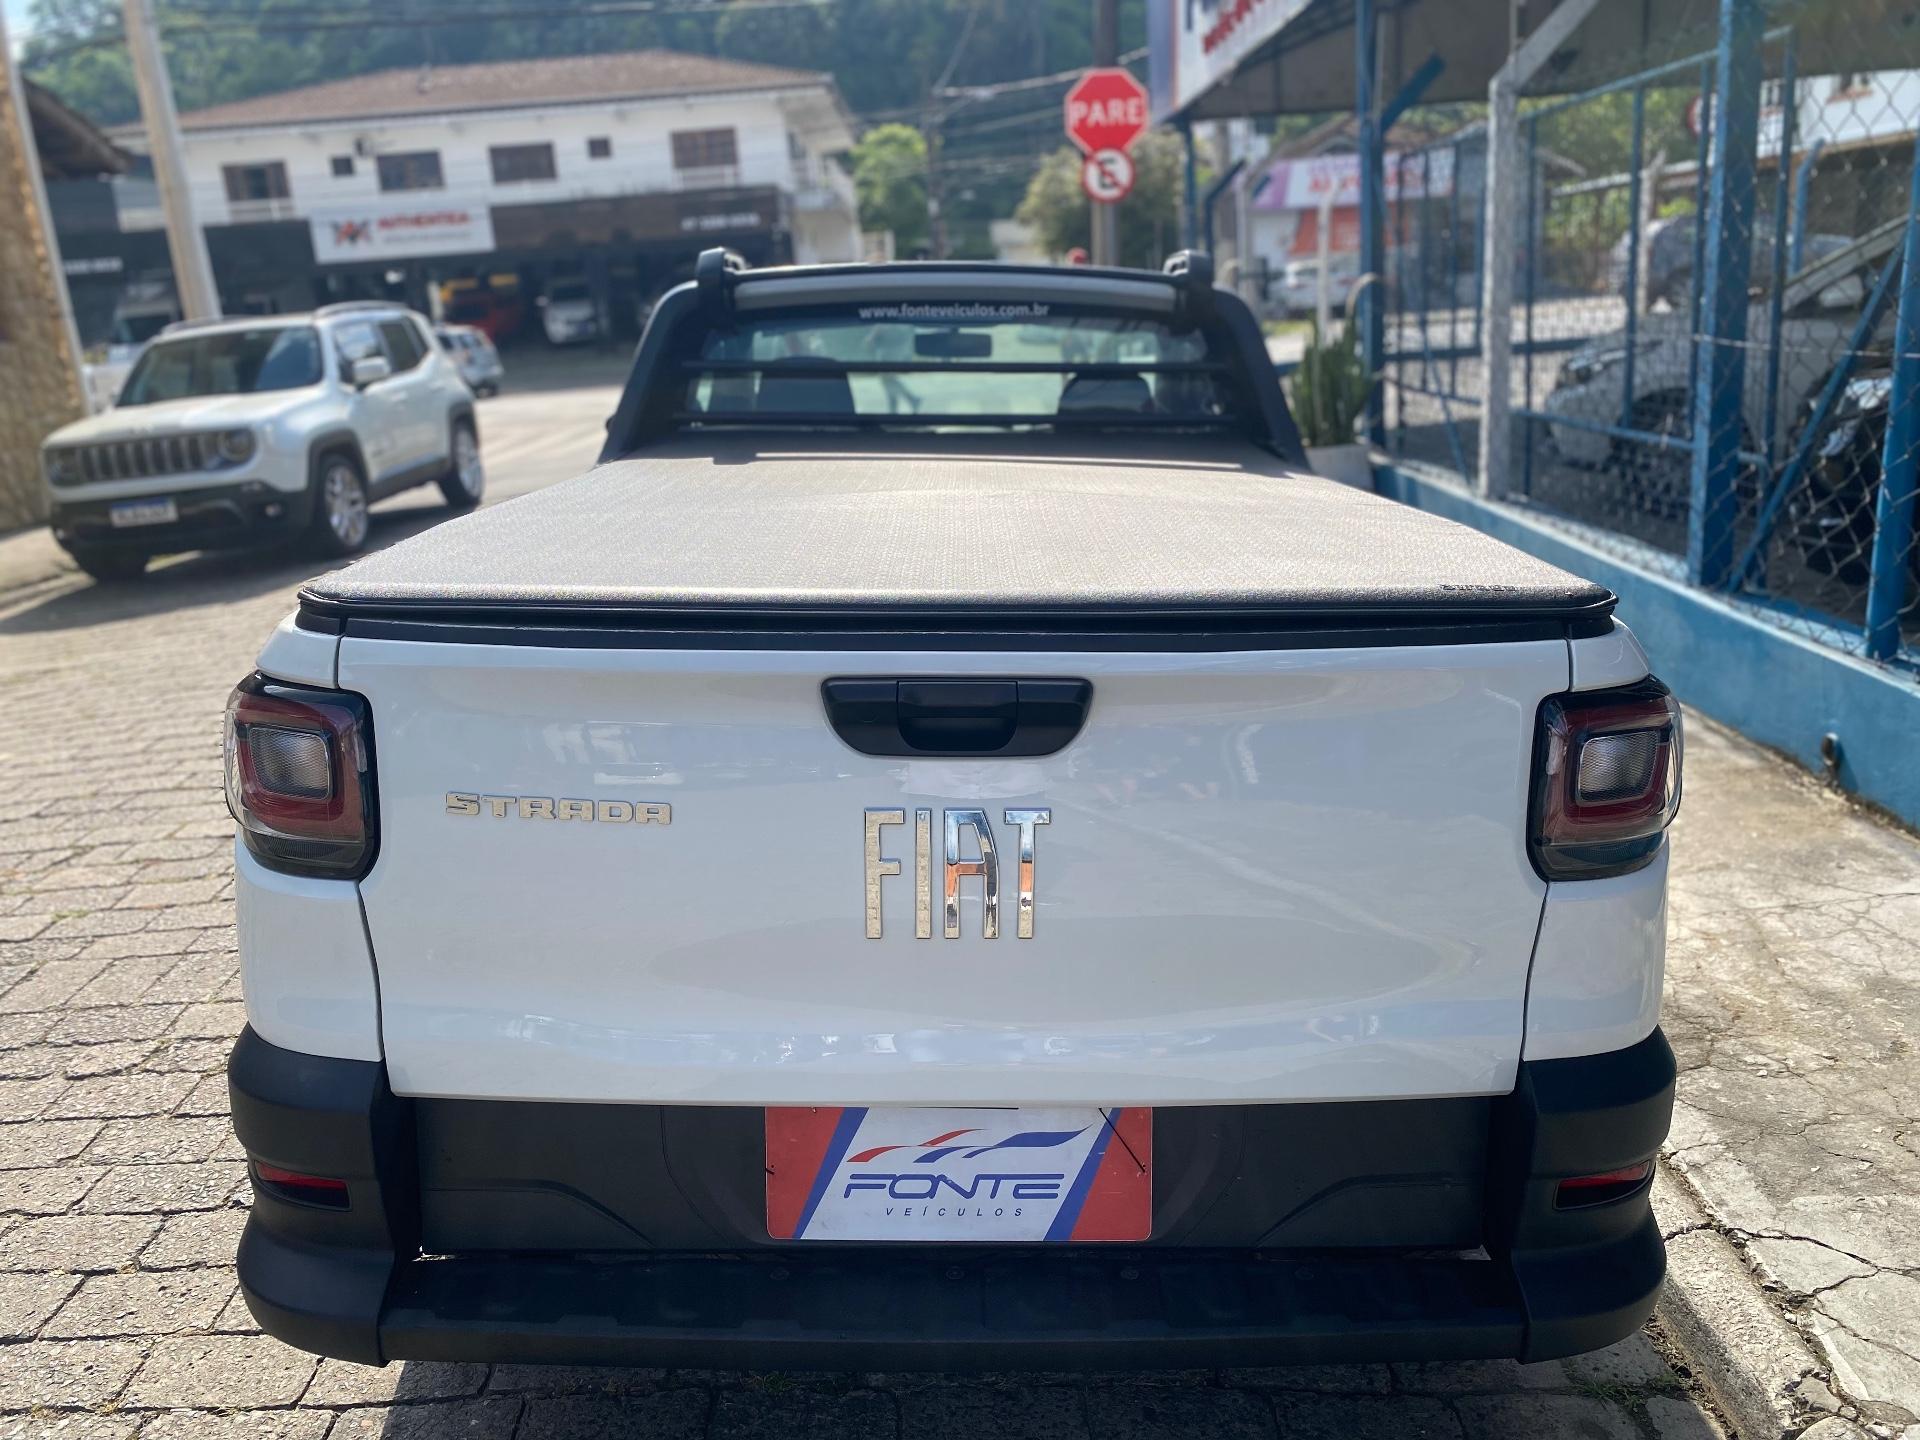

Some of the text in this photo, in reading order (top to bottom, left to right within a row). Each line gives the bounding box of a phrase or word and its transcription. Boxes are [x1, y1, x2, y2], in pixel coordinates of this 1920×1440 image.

[1068, 96, 1143, 128] PARE
[859, 303, 1050, 319] www.fonteveiculos.com.br
[446, 791, 673, 825] STRADA
[864, 807, 1052, 939] FIAT
[843, 1173, 1065, 1200] FONTE
[886, 1205, 1023, 1217] VEÍCULOS
